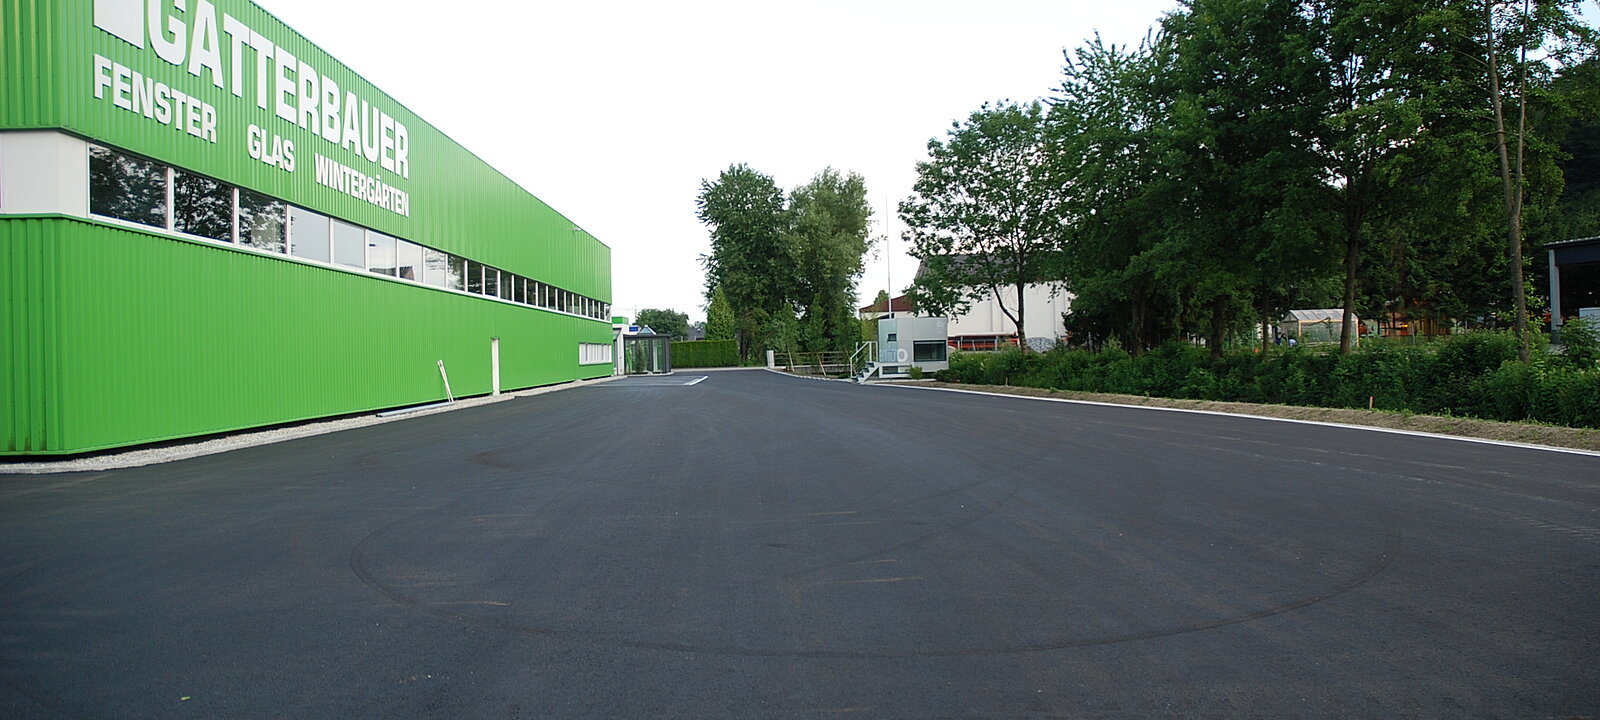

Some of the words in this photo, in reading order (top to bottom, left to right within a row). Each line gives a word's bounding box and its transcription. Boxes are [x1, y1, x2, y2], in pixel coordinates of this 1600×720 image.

[94, 53, 217, 143] FENSTER
[247, 124, 295, 173] GLAS
[314, 153, 409, 217] WINTERGÄRTEN
[147, 0, 409, 179] GATTERBAUER
